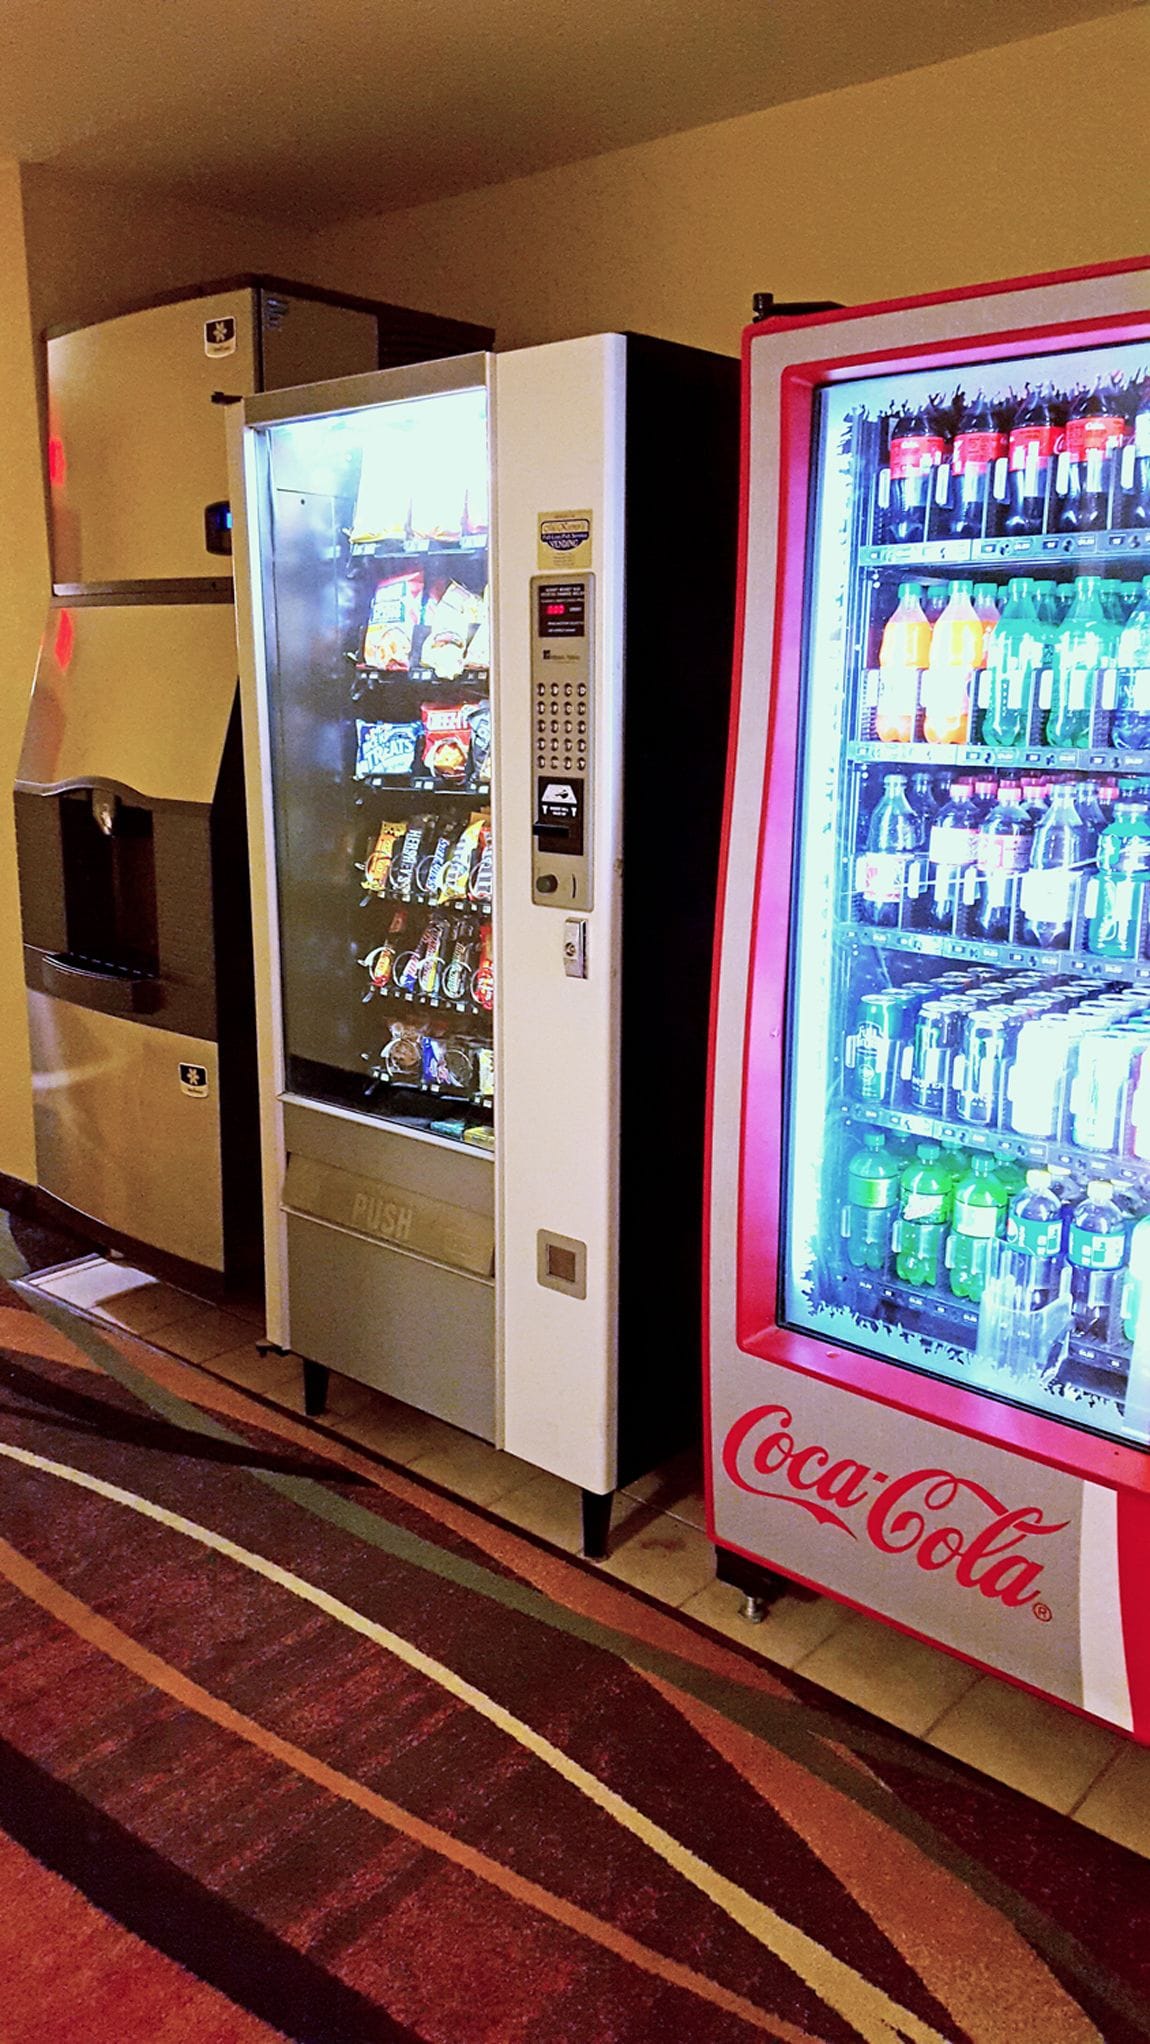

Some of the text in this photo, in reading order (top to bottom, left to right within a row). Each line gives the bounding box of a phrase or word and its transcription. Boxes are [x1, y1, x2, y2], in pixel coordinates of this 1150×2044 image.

[367, 740, 413, 770] TREATS
[428, 838, 448, 890] SNICKERS
[353, 1193, 413, 1240] PUSH
[723, 1404, 1070, 1608] Coca-Cola
